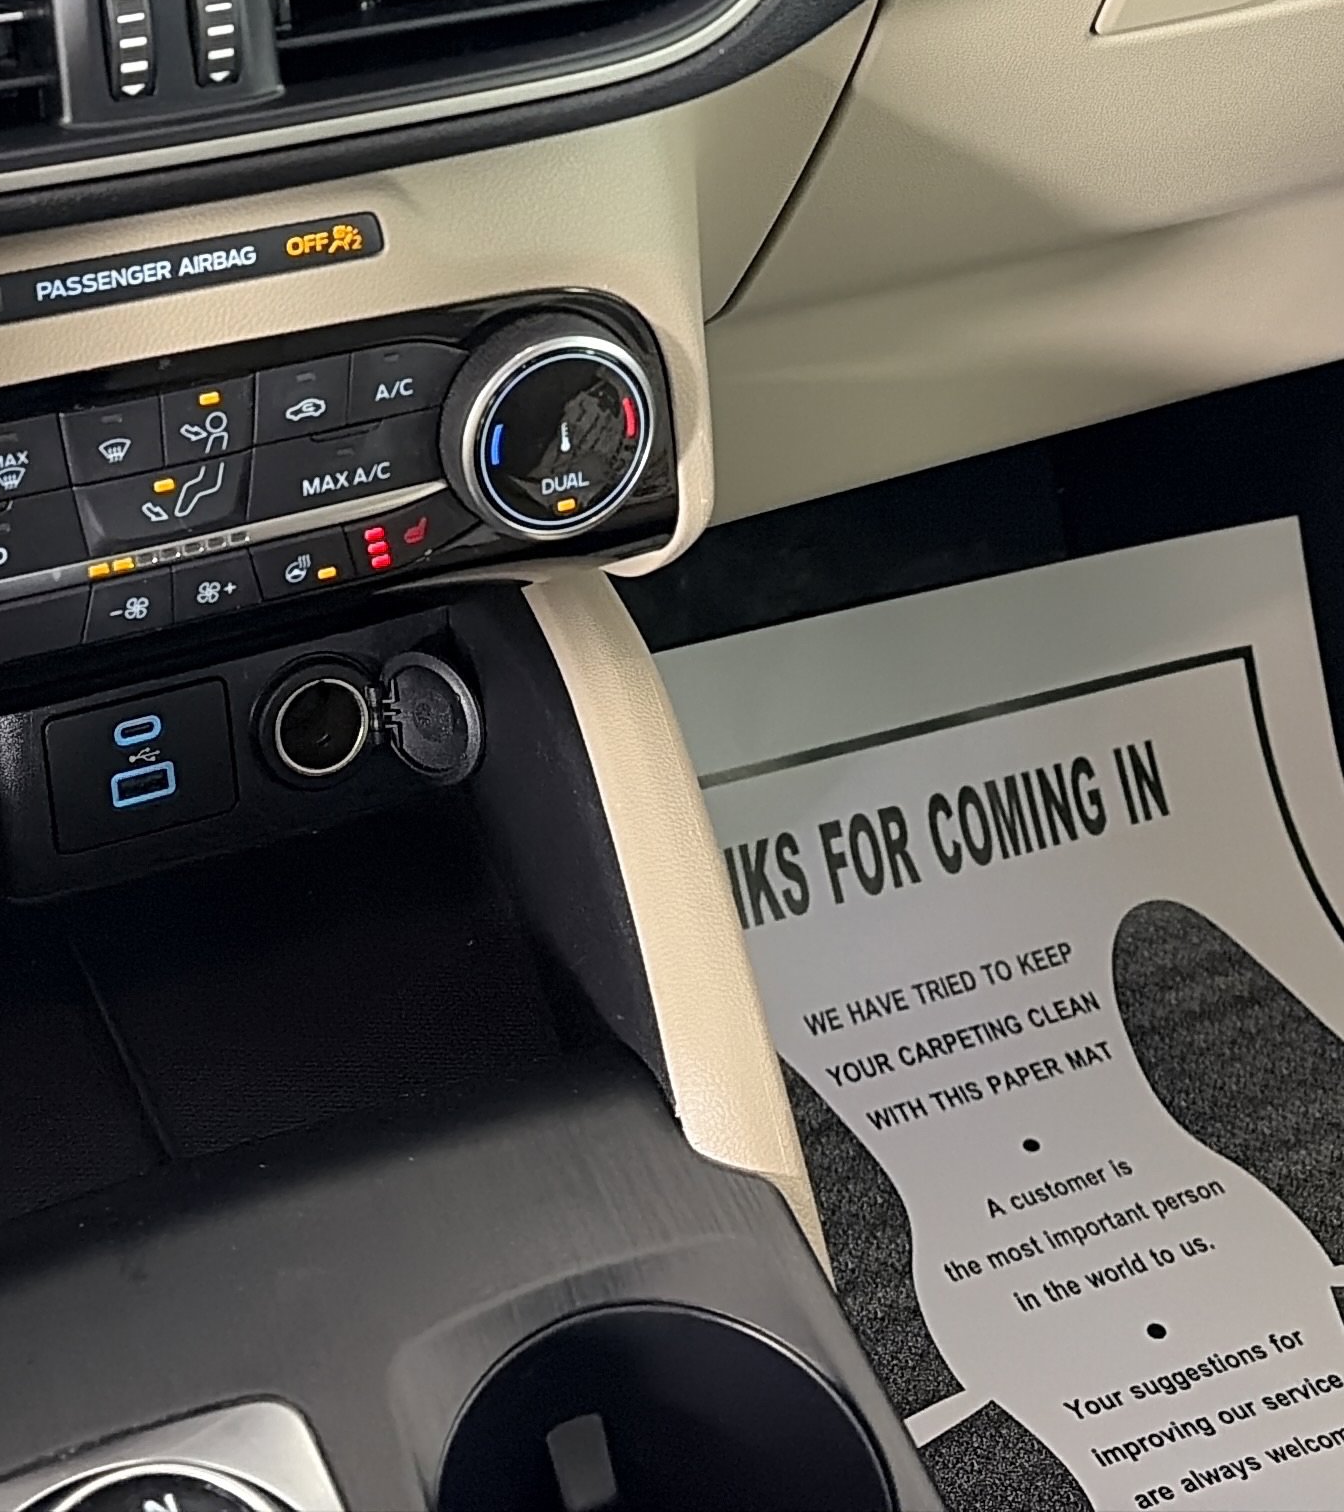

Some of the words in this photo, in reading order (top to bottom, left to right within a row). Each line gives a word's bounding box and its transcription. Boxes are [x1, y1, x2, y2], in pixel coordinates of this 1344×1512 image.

[36, 260, 171, 301] PASSENGER
[179, 246, 256, 277] AIRBAG
[286, 232, 329, 257] OFF
[375, 378, 413, 402] A/C
[302, 472, 350, 497] MAX
[353, 461, 391, 484] A/C
[541, 471, 590, 495] DUAL
[819, 805, 921, 904] FOR
[928, 756, 1106, 874] COMING
[1114, 740, 1170, 825] IN
[804, 1008, 843, 1036] WE
[846, 989, 909, 1026] HAVE
[911, 970, 976, 1007] TRIED
[980, 960, 1012, 984] TO
[1017, 942, 1073, 974] KEEP
[826, 1052, 894, 1088] YOUR
[898, 1015, 1022, 1066] CARPETING
[1027, 991, 1101, 1028] CLEAN
[866, 1097, 928, 1131] WITH
[930, 1082, 983, 1112] THIS
[986, 1059, 1060, 1095] PAPER
[1064, 1041, 1113, 1071] MAT
[986, 1198, 1006, 1219] A
[1009, 1171, 1104, 1212] customer
[1106, 1159, 1132, 1183] is
[945, 1258, 982, 1283] the
[987, 1238, 1044, 1272] most
[1049, 1201, 1151, 1247] important
[1152, 1177, 1226, 1221] person
[1013, 1290, 1042, 1312] in
[1043, 1275, 1082, 1302] the
[1085, 1254, 1147, 1288] world
[1150, 1244, 1175, 1267] to
[1179, 1235, 1216, 1259] us.
[1064, 1389, 1125, 1422] Your
[1129, 1341, 1267, 1402] suggestions
[1268, 1327, 1304, 1355] for
[1091, 1415, 1216, 1467] improving
[1218, 1401, 1256, 1427] our
[1261, 1371, 1344, 1414] service
[1135, 1485, 1175, 1510] are
[1180, 1453, 1262, 1493] always
